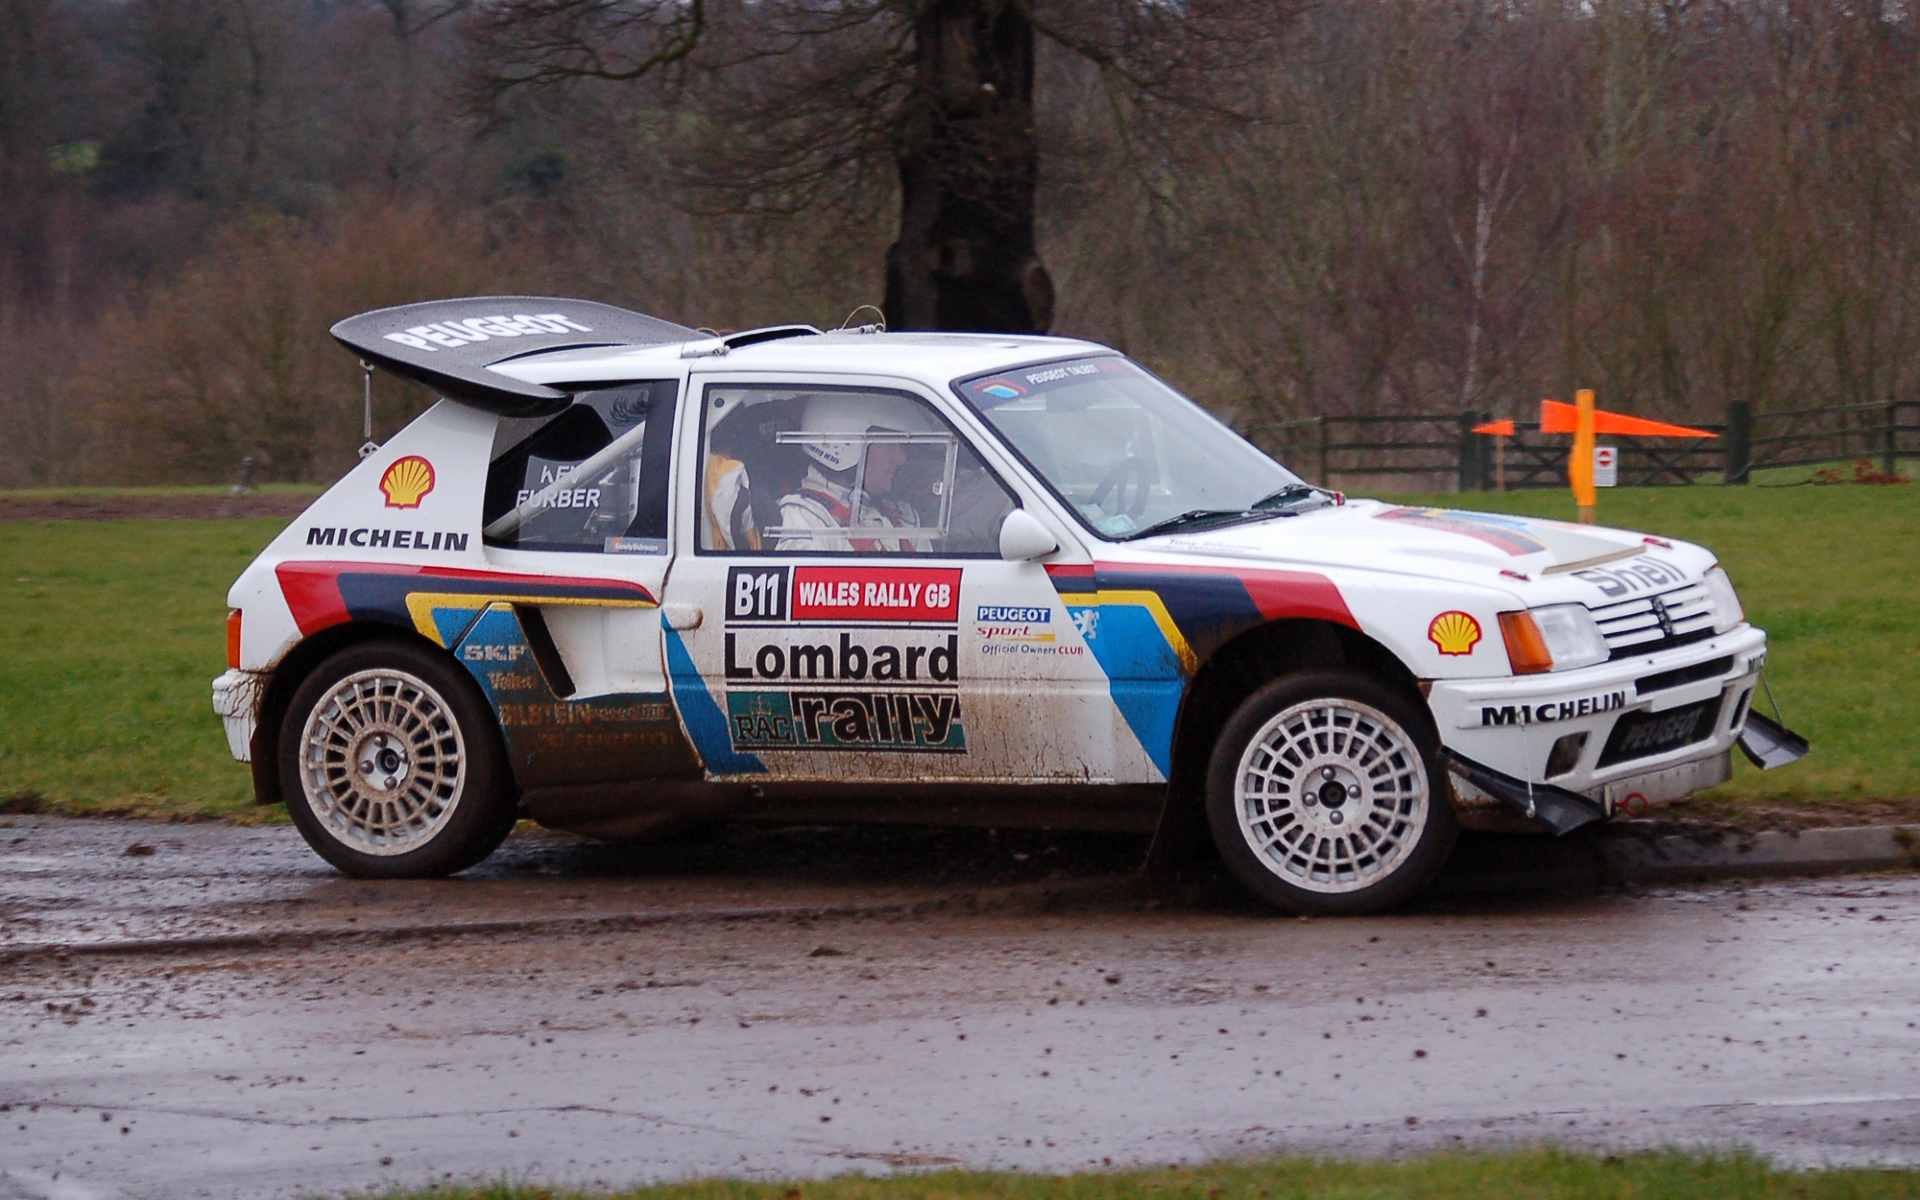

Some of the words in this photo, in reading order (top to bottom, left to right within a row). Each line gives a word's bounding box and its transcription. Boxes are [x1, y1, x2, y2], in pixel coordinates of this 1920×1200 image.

[384, 313, 593, 352] PEUGEOT
[1025, 372, 1067, 385] PEUGEOT
[306, 527, 469, 551] MICHELIN
[1571, 556, 1688, 597] Shell
[734, 571, 778, 617] B11
[799, 582, 860, 607] WALES
[864, 582, 922, 607] RALLY
[924, 583, 951, 608] GB
[979, 607, 1049, 622] PEUGEOT
[976, 626, 1030, 639] sport
[464, 645, 527, 661] SKF
[725, 632, 958, 682] Lombard
[982, 644, 1019, 656] Official
[1021, 644, 1057, 654] Owners
[1058, 646, 1084, 655] CLUB
[798, 693, 958, 745] rally
[1481, 691, 1627, 727] MICHELIN
[734, 713, 793, 742] RAC
